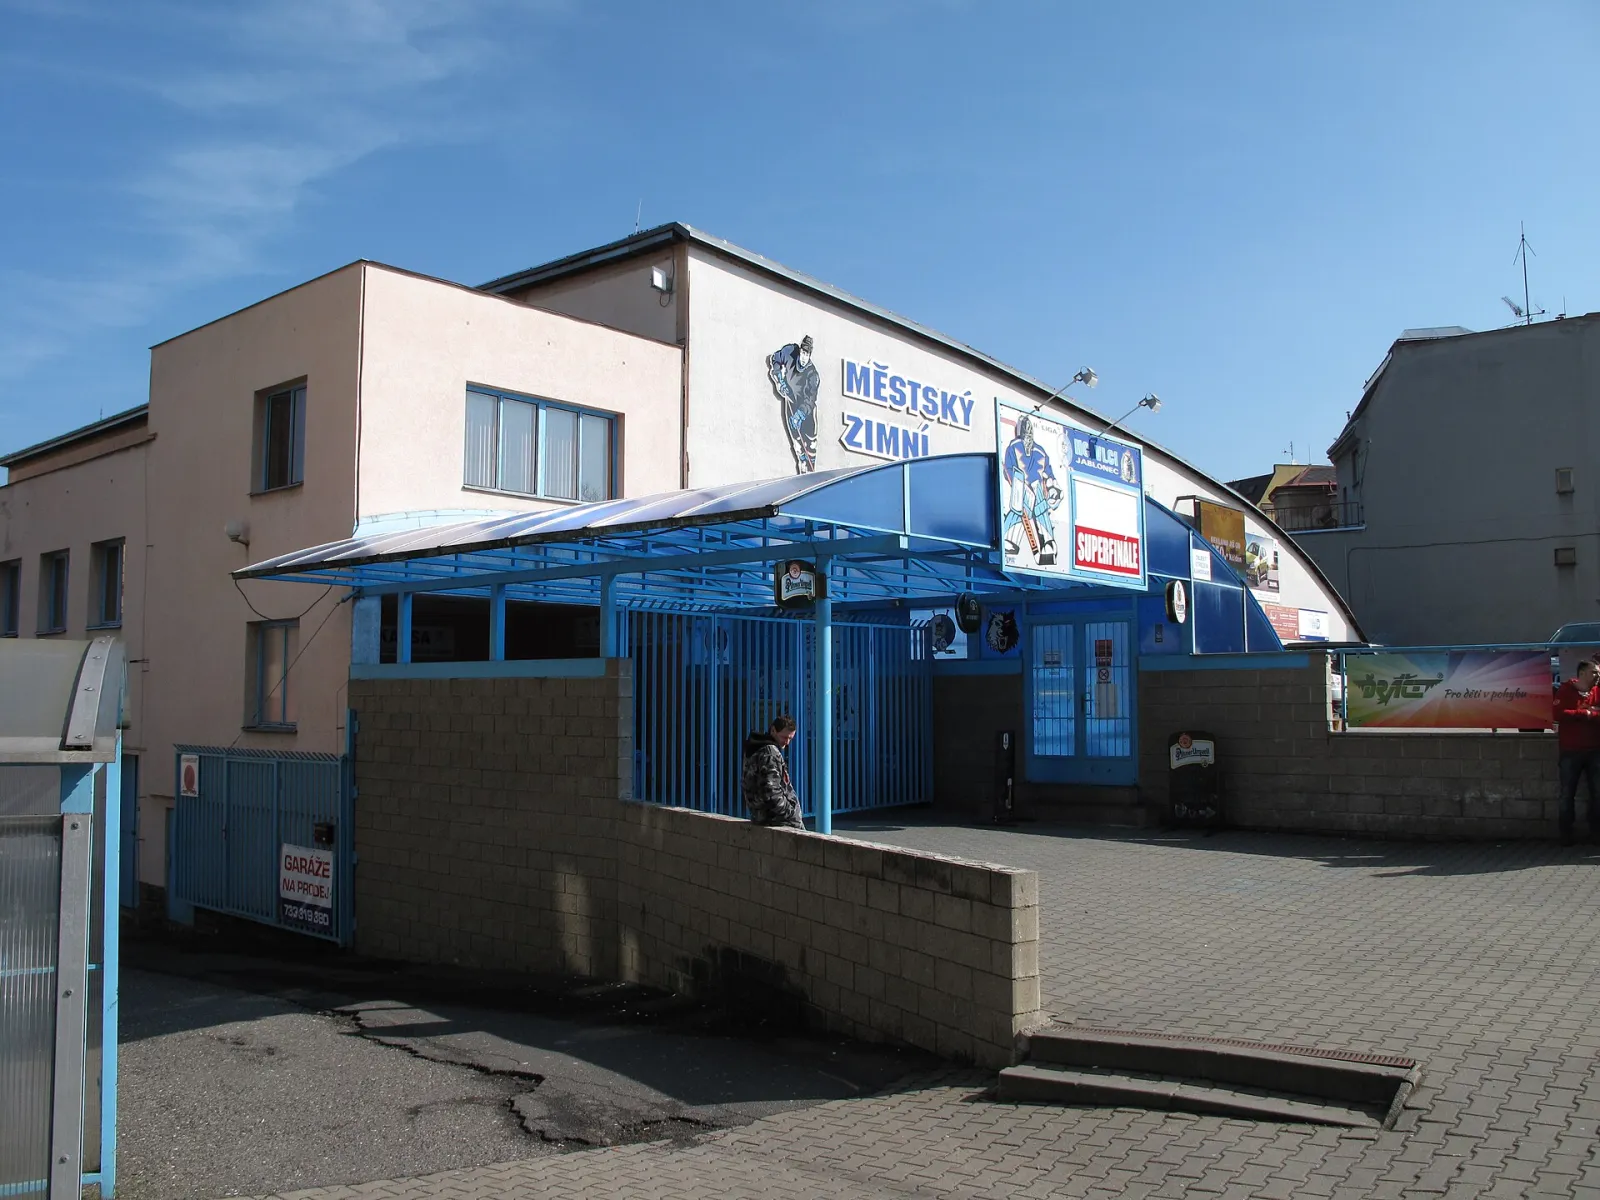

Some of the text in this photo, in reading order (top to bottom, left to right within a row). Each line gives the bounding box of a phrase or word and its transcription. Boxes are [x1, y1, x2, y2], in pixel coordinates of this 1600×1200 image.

[845, 361, 975, 427] MĚSTSKÝ
[844, 414, 929, 459] ZIMNÍ
[1041, 425, 1058, 435] LIGA
[1075, 457, 1119, 475] JABLONEC
[1077, 532, 1139, 570] SUPERFINÁLE
[1444, 688, 1462, 699] Pro
[1463, 687, 1482, 699] děti
[1490, 687, 1527, 702] pohybu
[285, 855, 330, 878] GARÁŽE
[282, 878, 330, 900] NA PRODEJ
[283, 904, 298, 918] 733
